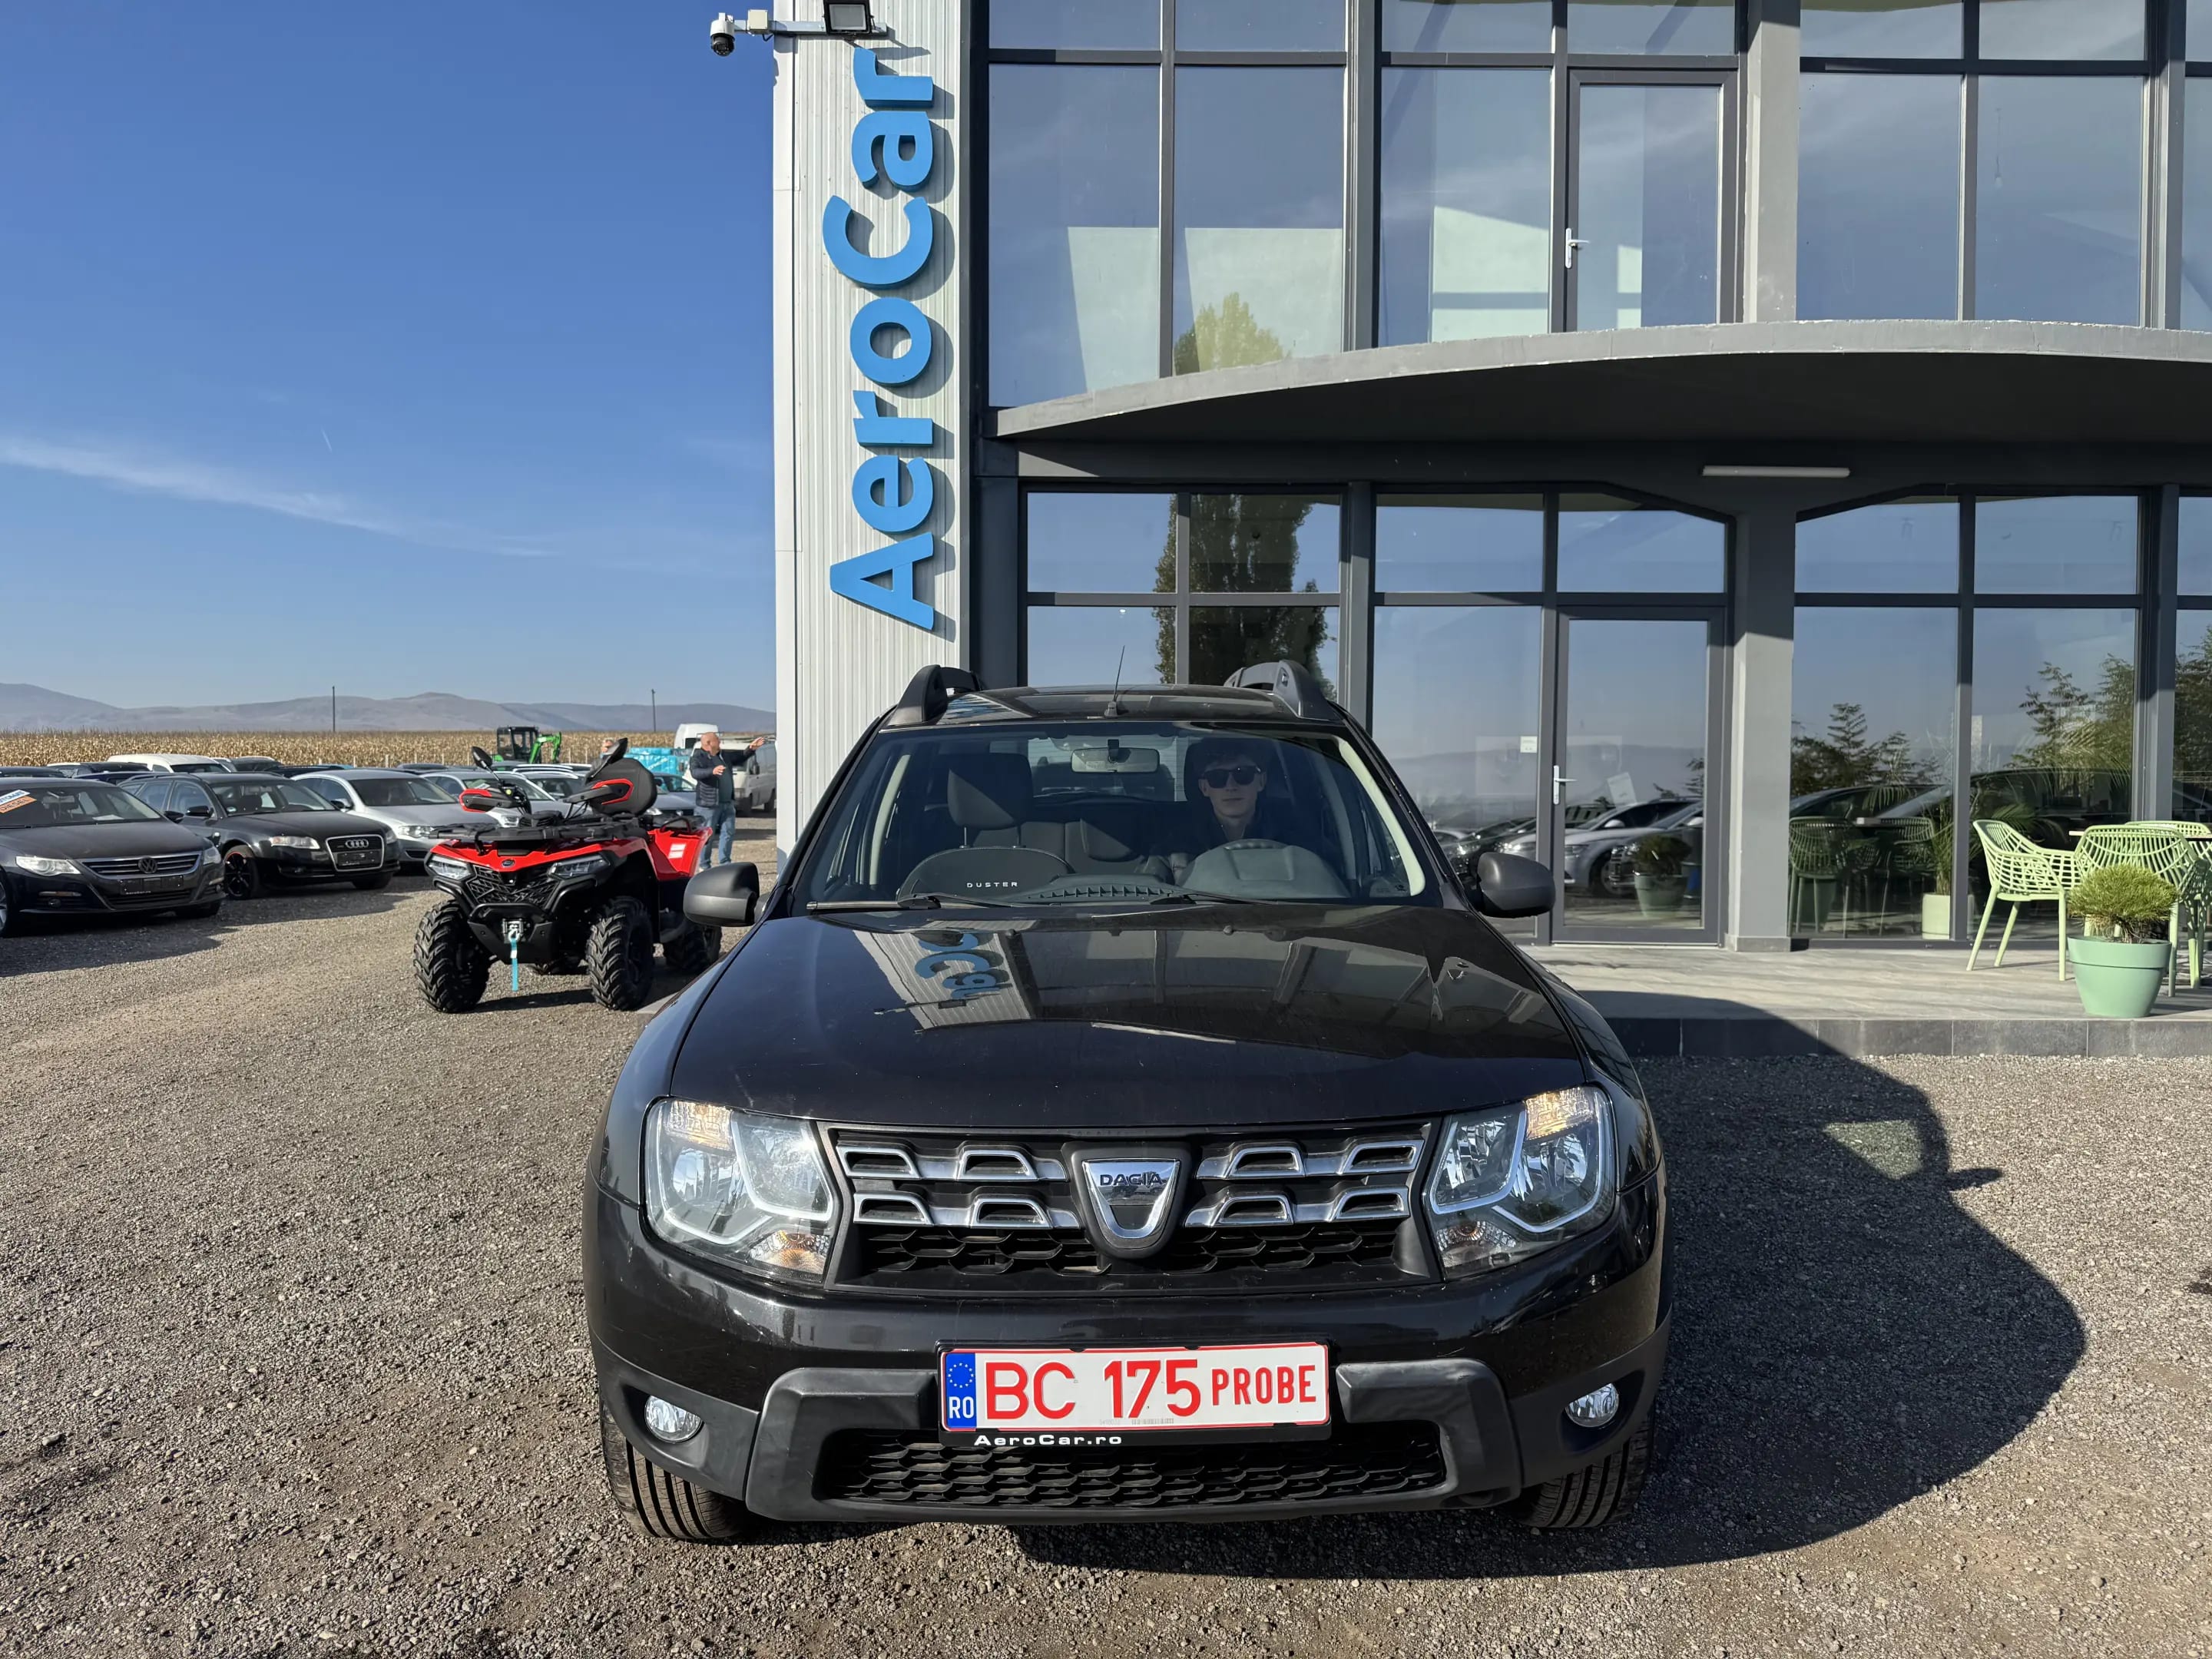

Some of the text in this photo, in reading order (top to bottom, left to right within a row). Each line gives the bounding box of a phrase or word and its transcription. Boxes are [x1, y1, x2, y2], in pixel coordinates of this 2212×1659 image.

[823, 47, 935, 631] AeroCar
[1099, 1173, 1164, 1187] DACIA
[985, 1359, 1317, 1420] BC 175 PROBE
[948, 1396, 975, 1419] RO
[973, 1434, 1122, 1446] AeroCar.ro
